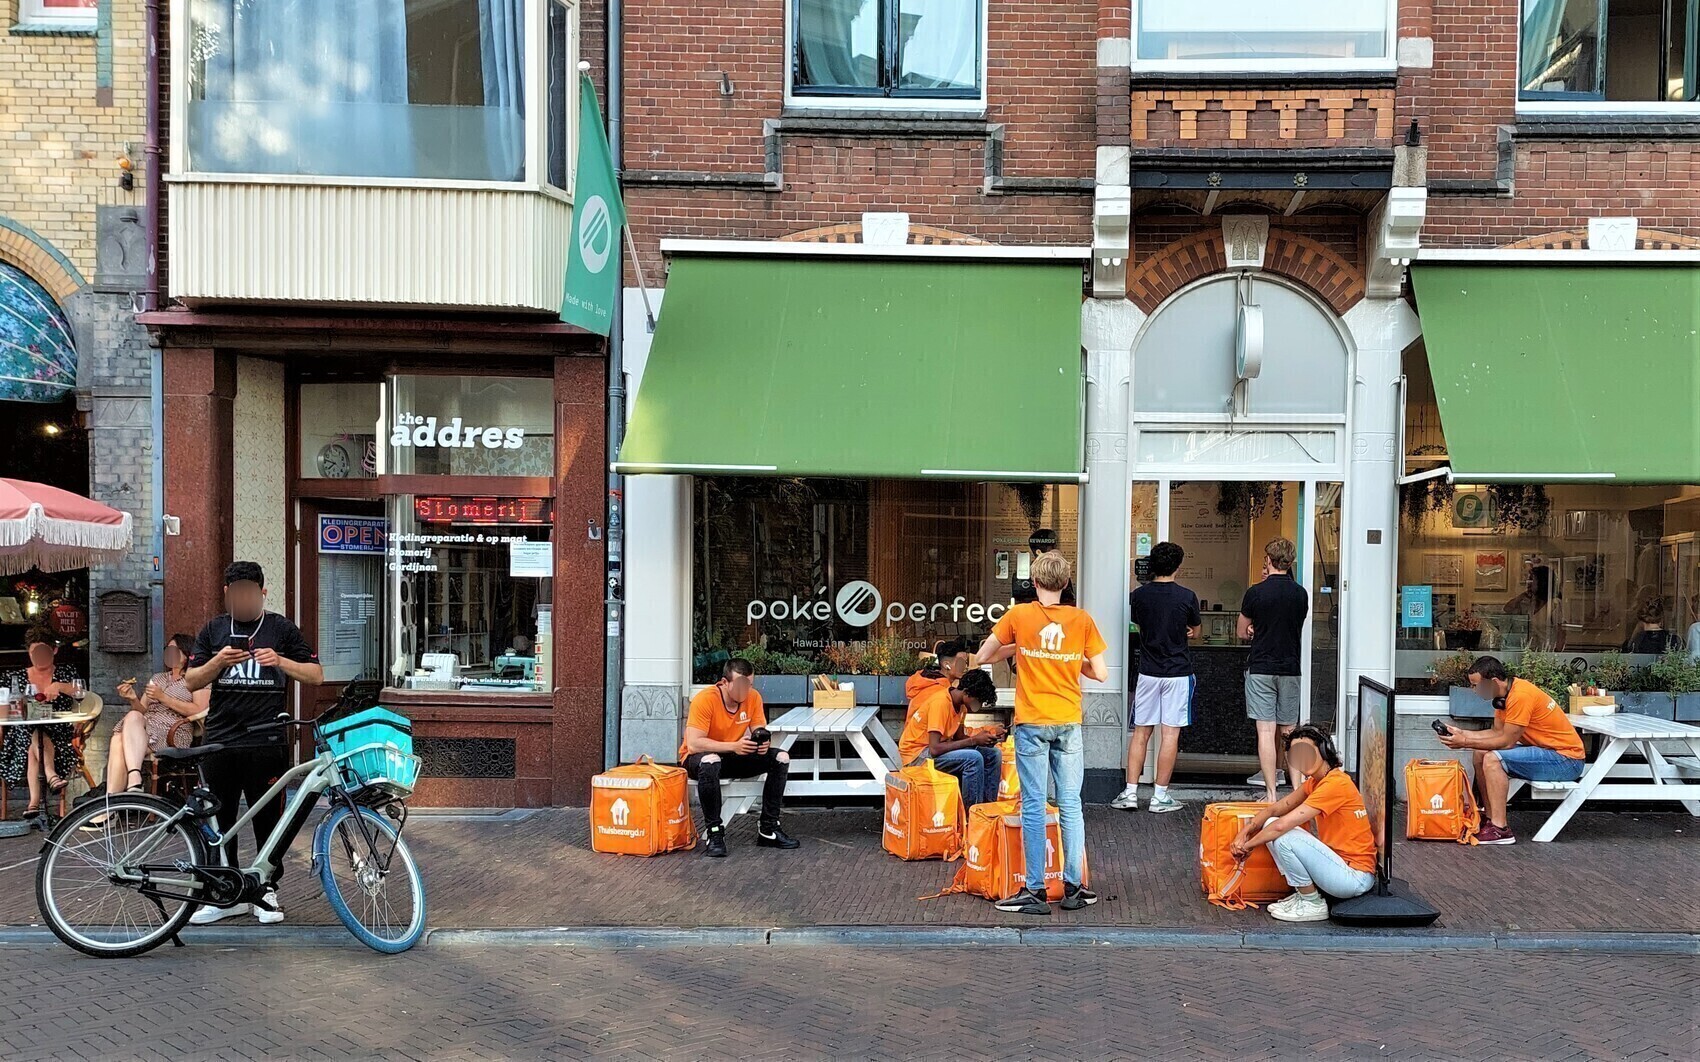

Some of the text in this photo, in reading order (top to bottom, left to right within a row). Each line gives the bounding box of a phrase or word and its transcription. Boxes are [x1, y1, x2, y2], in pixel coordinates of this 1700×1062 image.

[581, 300, 593, 311] with
[595, 303, 607, 317] love
[399, 412, 424, 425] the
[390, 417, 524, 449] addres
[420, 500, 526, 521] Stomerij
[323, 525, 386, 545] OPEN
[476, 533, 485, 543] &
[486, 535, 500, 545] op
[501, 535, 528, 544] maat
[388, 547, 432, 559] Stomerij
[388, 563, 438, 574] Gordijnen
[746, 586, 832, 626] poké
